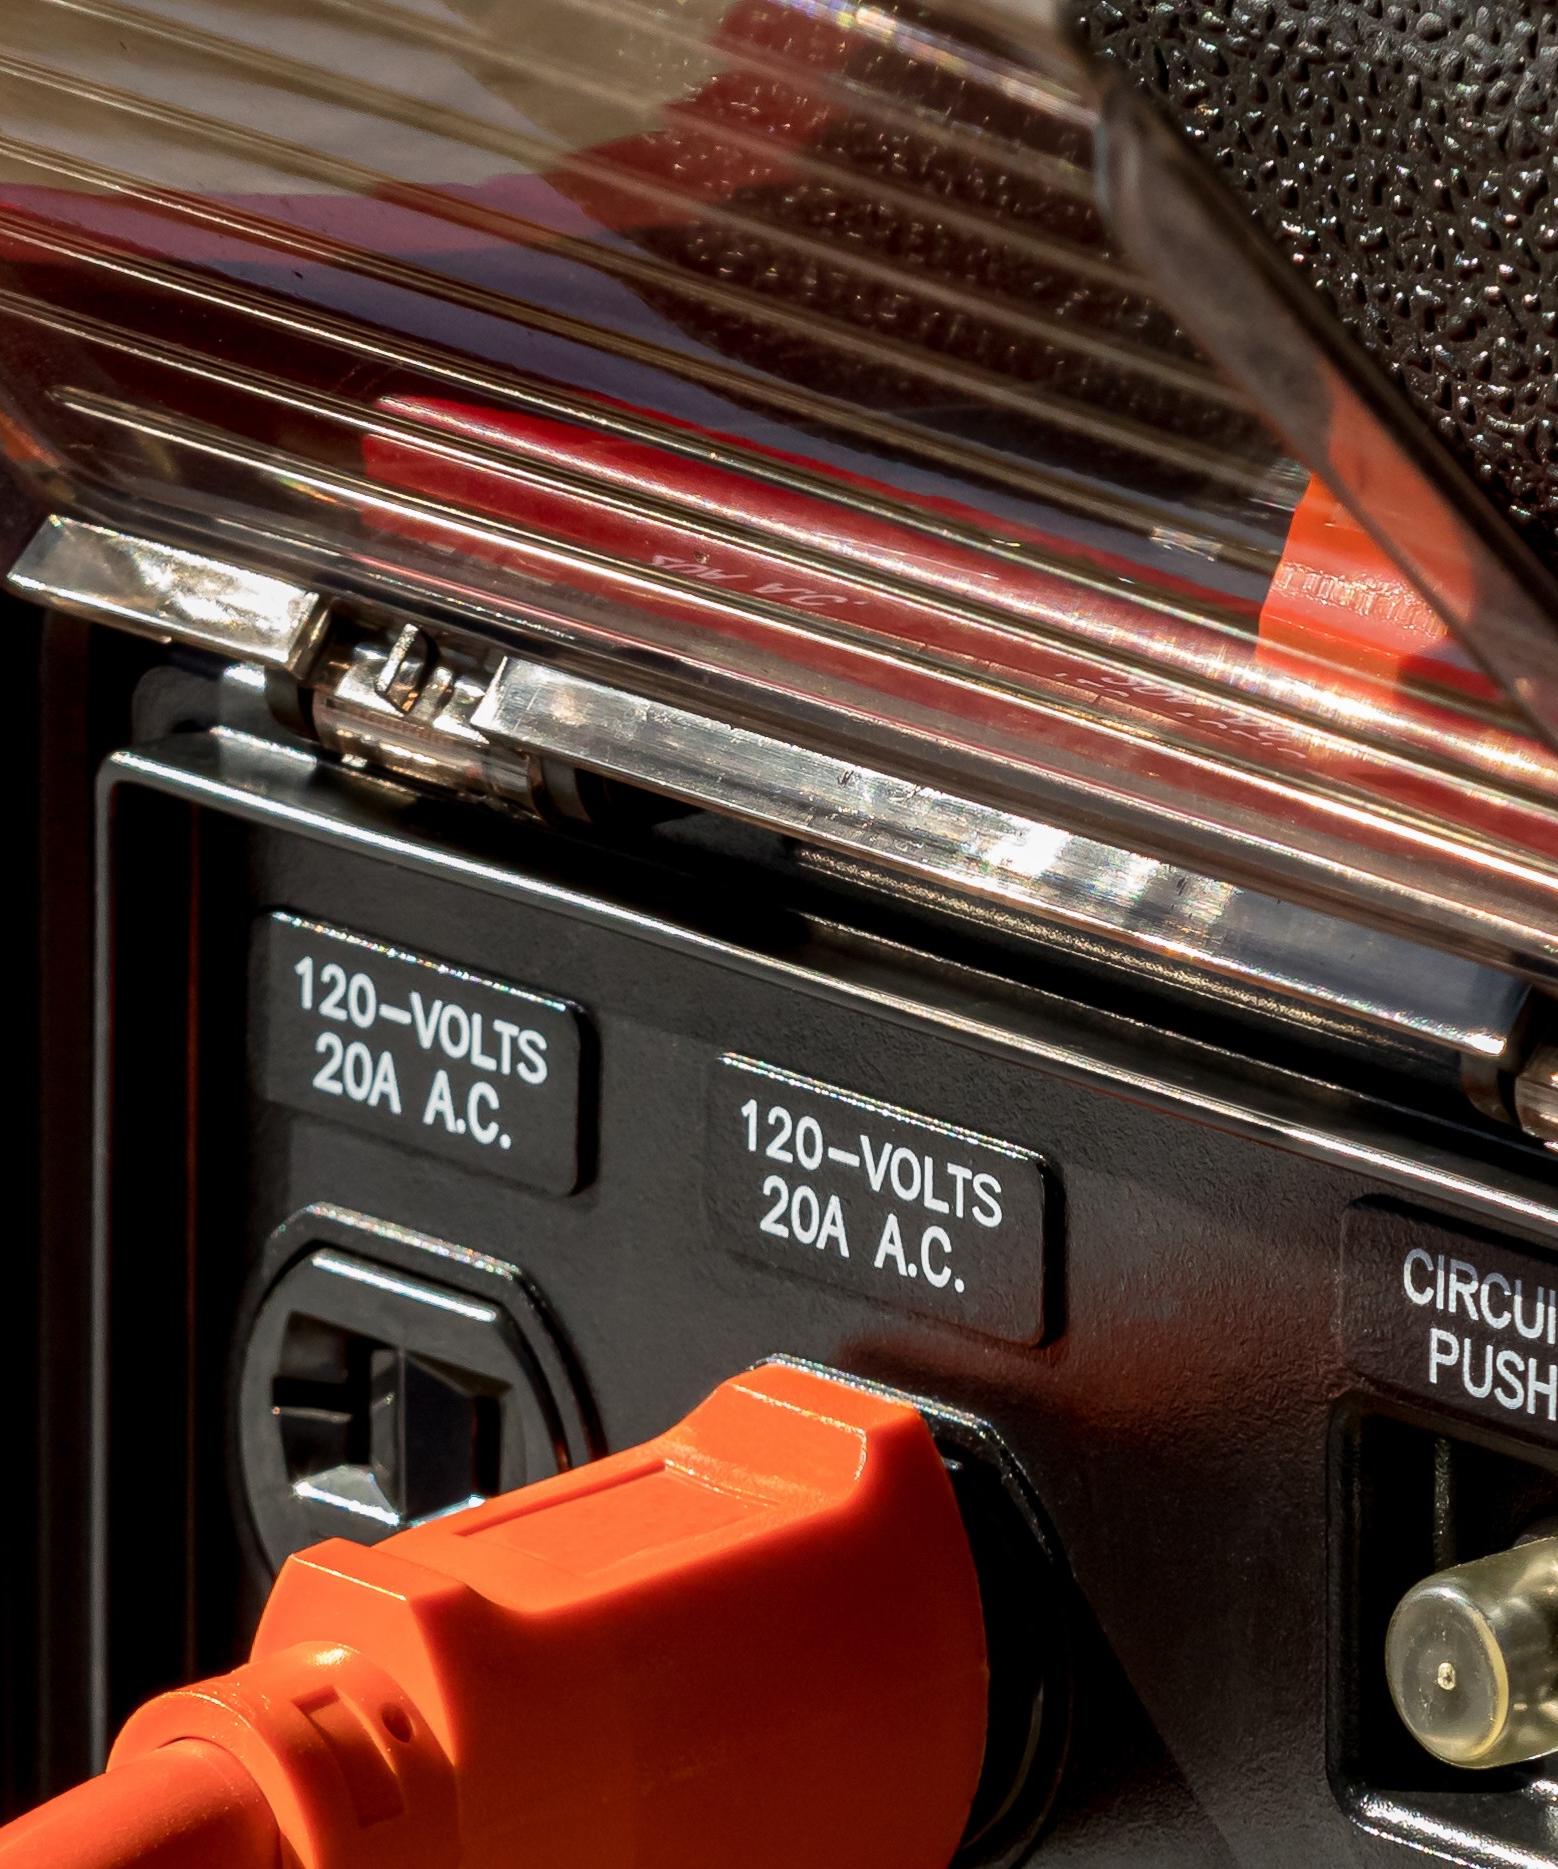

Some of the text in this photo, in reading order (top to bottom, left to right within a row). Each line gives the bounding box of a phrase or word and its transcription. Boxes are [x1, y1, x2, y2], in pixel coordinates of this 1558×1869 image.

[293, 955, 549, 1086] 120-VOLTS
[311, 1030, 513, 1151] 20A A.C.
[739, 1097, 1004, 1229] 120-VOLTS
[758, 1174, 966, 1294] 20A A.C.
[1428, 1326, 1558, 1423] PUSH
